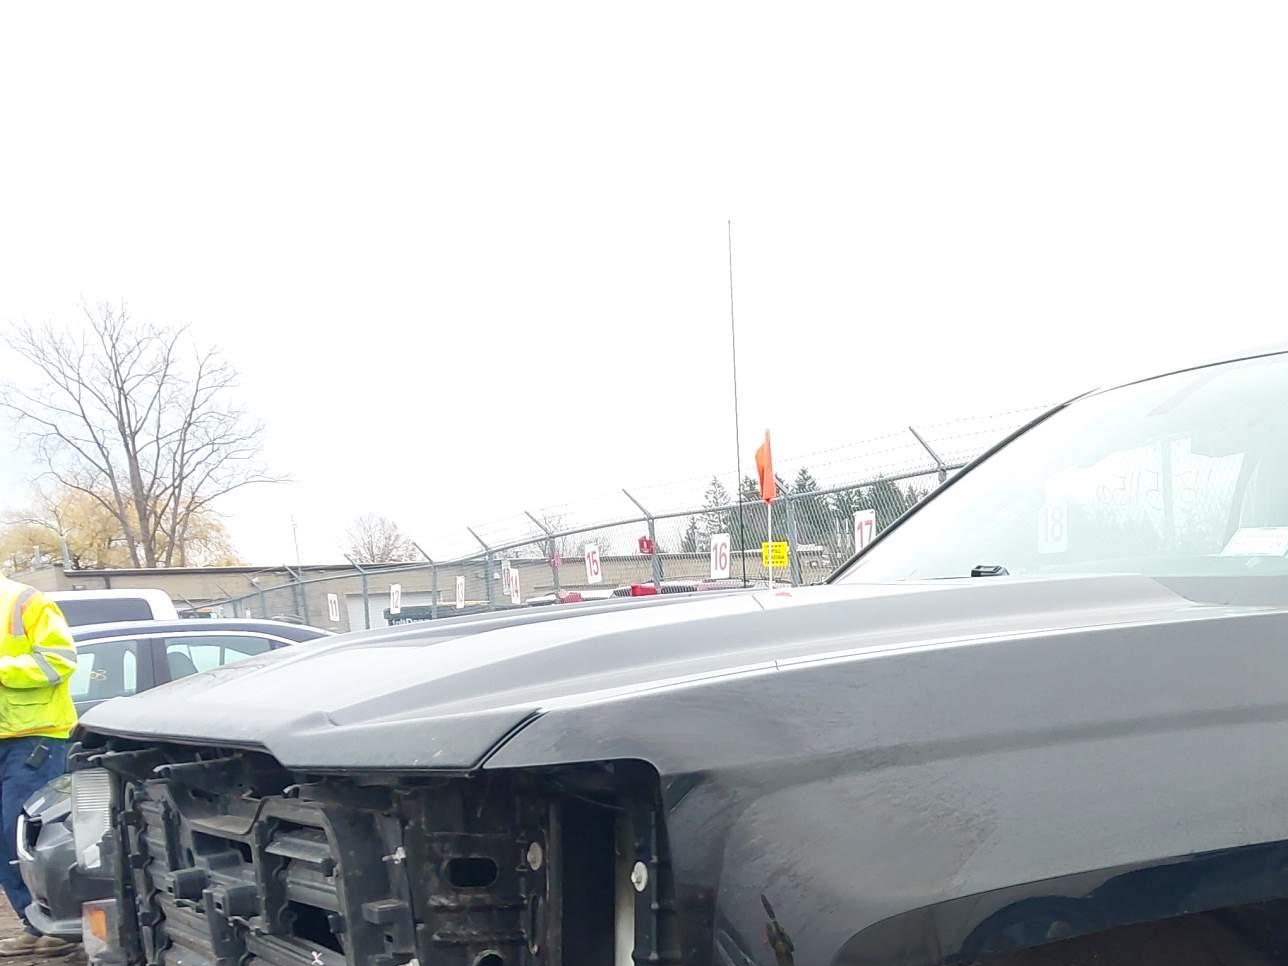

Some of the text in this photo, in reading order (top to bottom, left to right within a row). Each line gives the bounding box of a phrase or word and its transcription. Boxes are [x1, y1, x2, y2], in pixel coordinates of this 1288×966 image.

[856, 519, 874, 549] 17
[1040, 503, 1065, 544] 18
[586, 550, 600, 577] 15
[712, 541, 728, 571] 16
[329, 599, 338, 617] 11
[391, 591, 400, 610] 12
